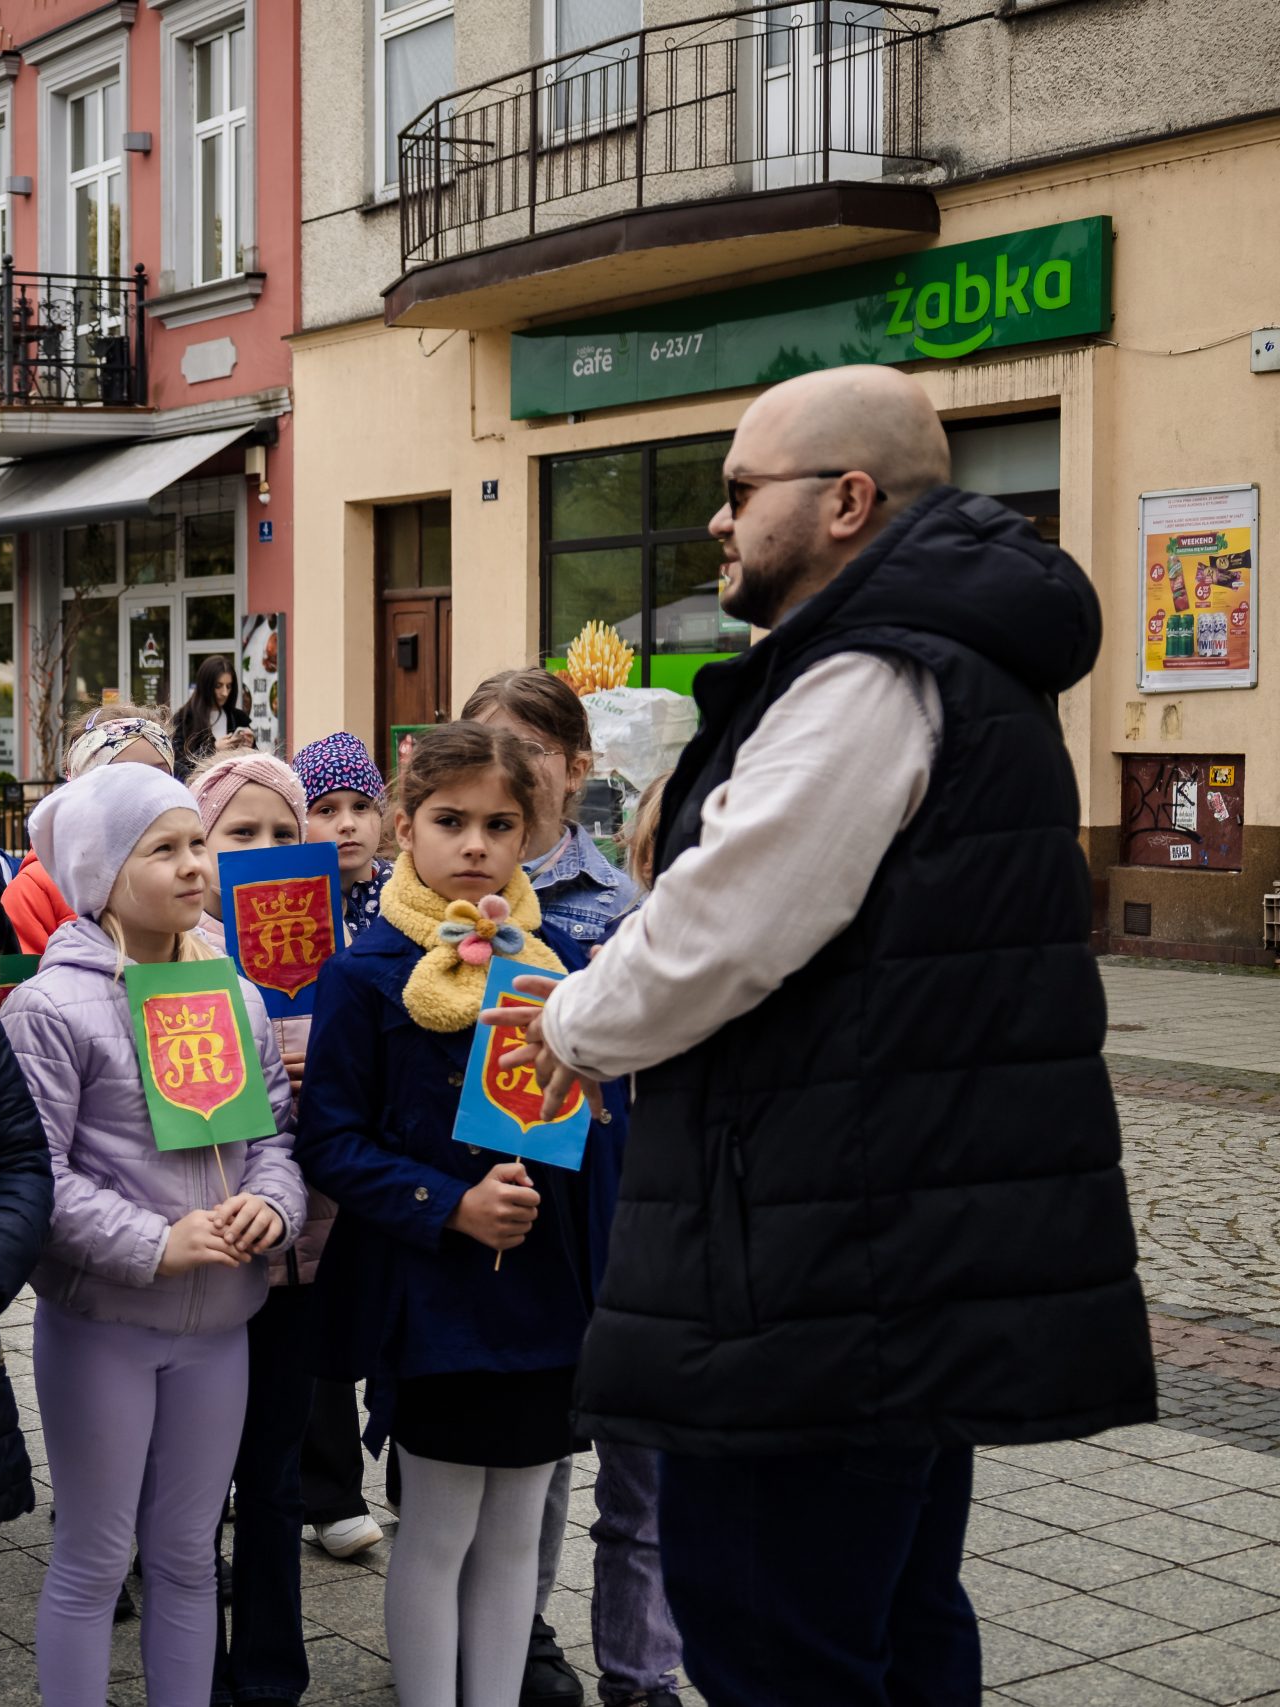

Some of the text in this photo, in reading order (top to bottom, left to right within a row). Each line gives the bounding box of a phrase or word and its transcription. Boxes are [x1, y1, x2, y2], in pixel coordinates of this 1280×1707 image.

[885, 254, 1071, 335] żabka
[650, 333, 704, 361] 6-23/7
[486, 482, 492, 494] 3
[263, 522, 269, 535] 4
[1181, 536, 1214, 546] WEEKEND
